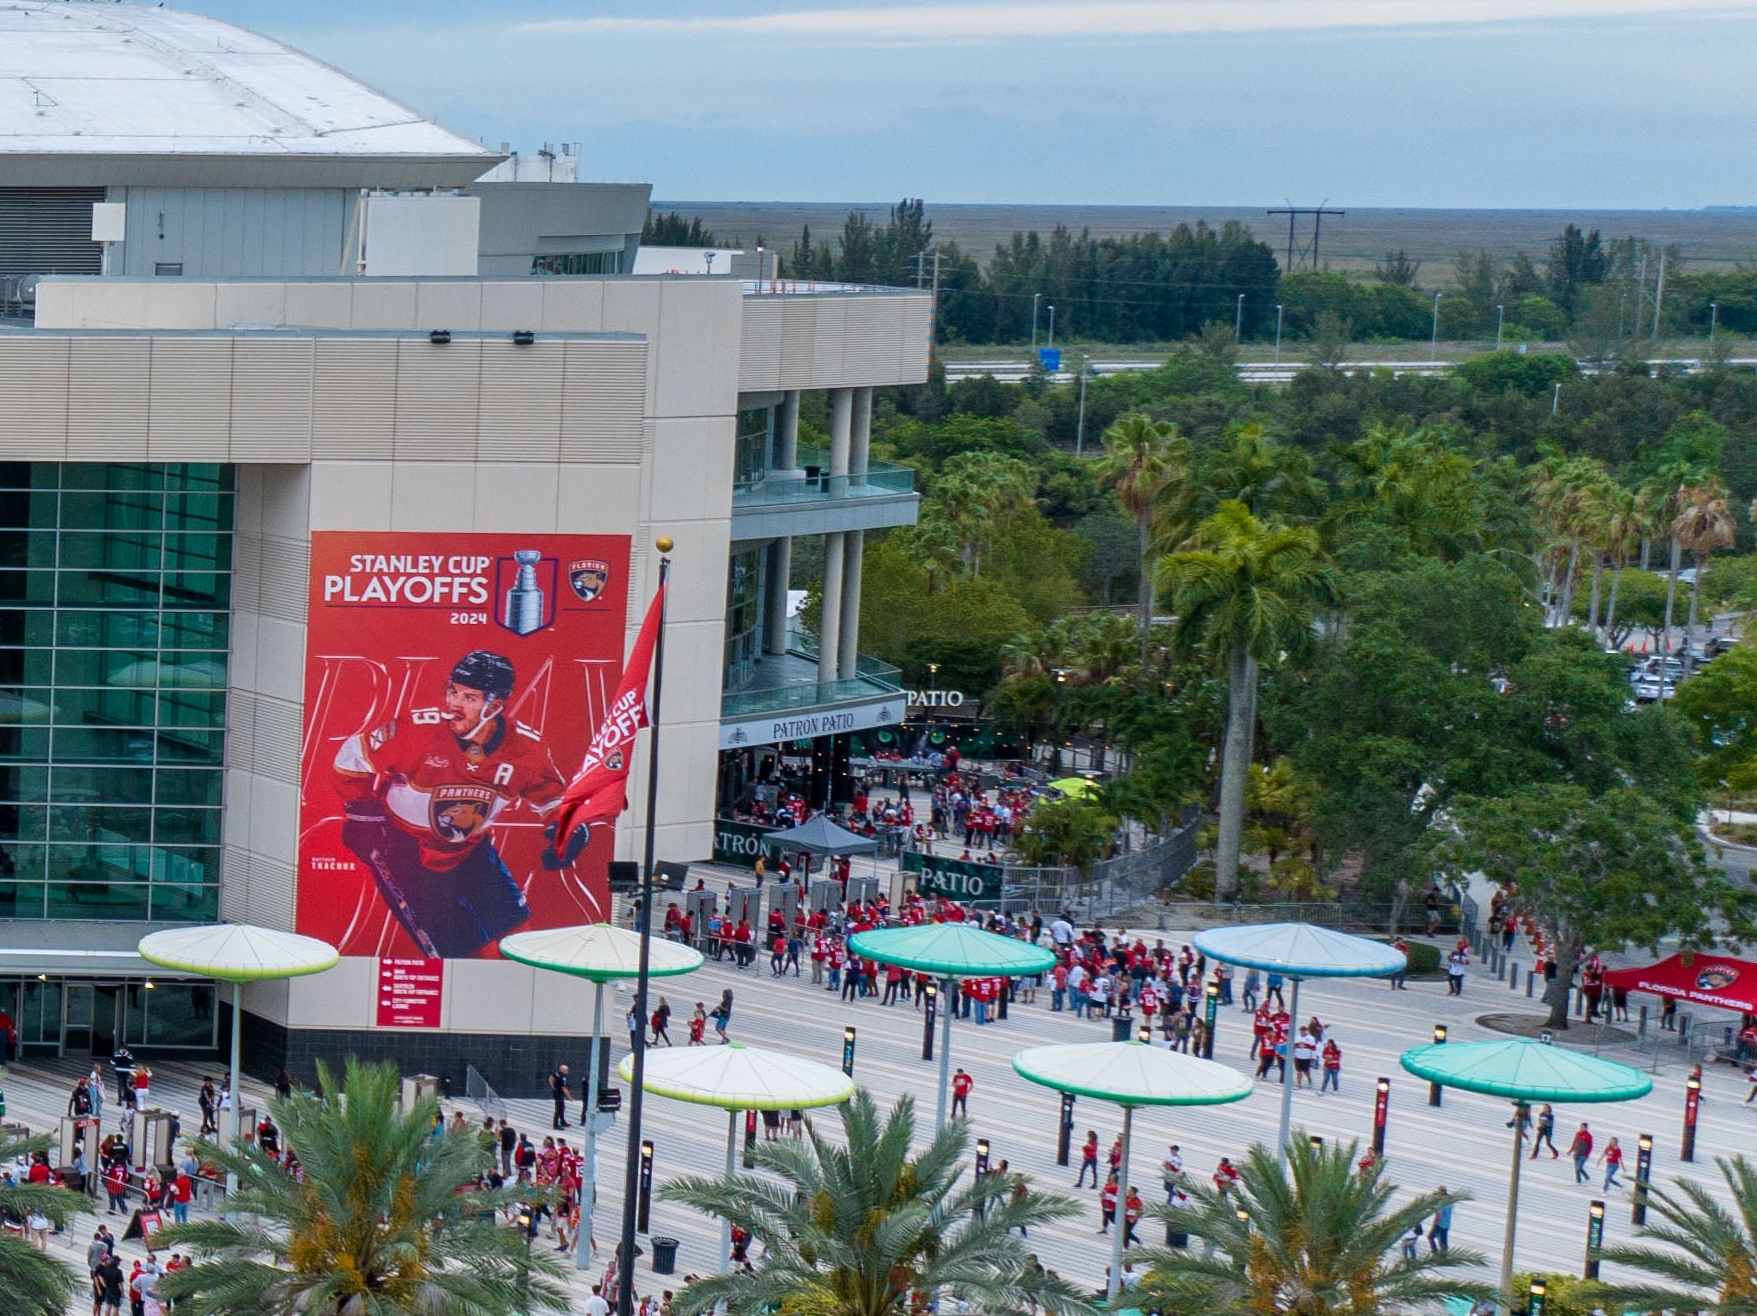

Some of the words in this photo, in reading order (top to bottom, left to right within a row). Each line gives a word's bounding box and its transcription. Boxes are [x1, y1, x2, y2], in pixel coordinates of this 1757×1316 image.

[349, 554, 444, 574] STANLEY
[447, 555, 490, 575] CUP
[324, 575, 489, 604] PLAYOFFS
[450, 613, 487, 625] 2024
[906, 690, 964, 707] PATIO
[773, 717, 818, 739] PATRÓN
[821, 712, 854, 731] PATIO
[493, 762, 514, 785] A
[439, 786, 492, 800] PANTHERS
[920, 867, 984, 896] PATIO
